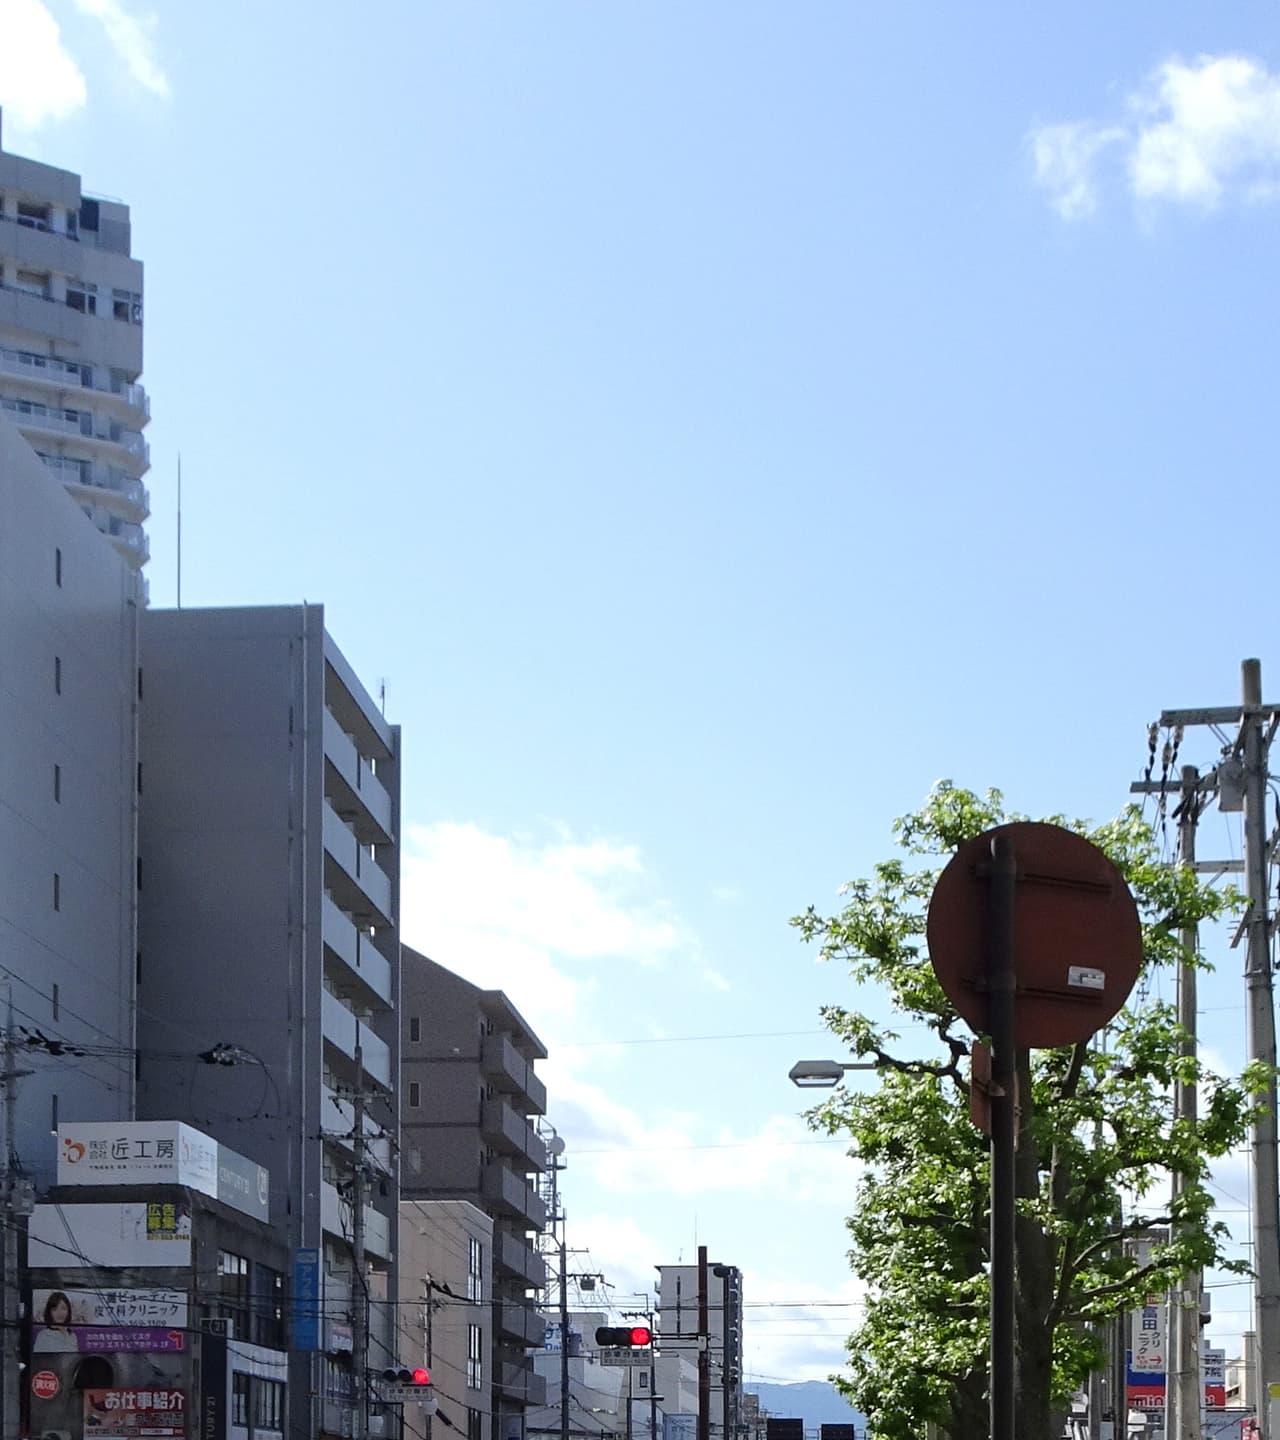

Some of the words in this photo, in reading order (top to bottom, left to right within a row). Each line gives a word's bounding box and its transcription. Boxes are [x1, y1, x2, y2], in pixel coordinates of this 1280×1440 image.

[111, 1137, 174, 1160] 匠工房
[148, 1203, 176, 1216] 広告
[35, 1378, 57, 1391] 消火栓
[104, 1391, 185, 1410] お仕事紹介
